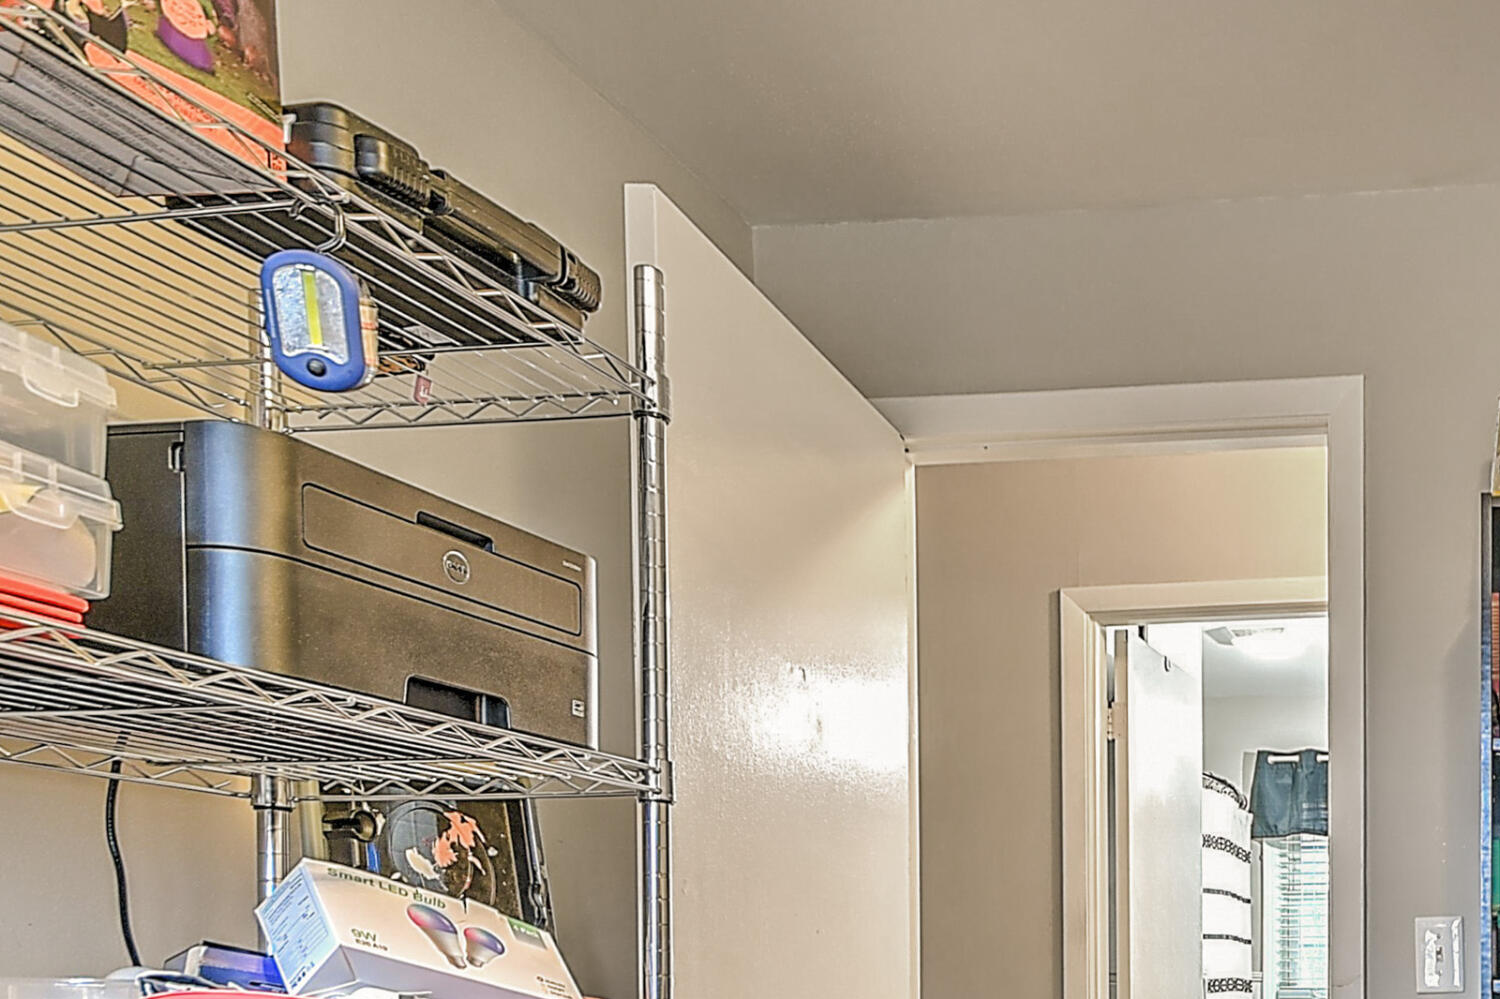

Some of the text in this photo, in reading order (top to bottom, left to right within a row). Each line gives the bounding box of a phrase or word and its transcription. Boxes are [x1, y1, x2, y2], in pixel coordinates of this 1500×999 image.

[327, 867, 446, 909] Smart LED Bulb
[351, 928, 377, 942] 9W
